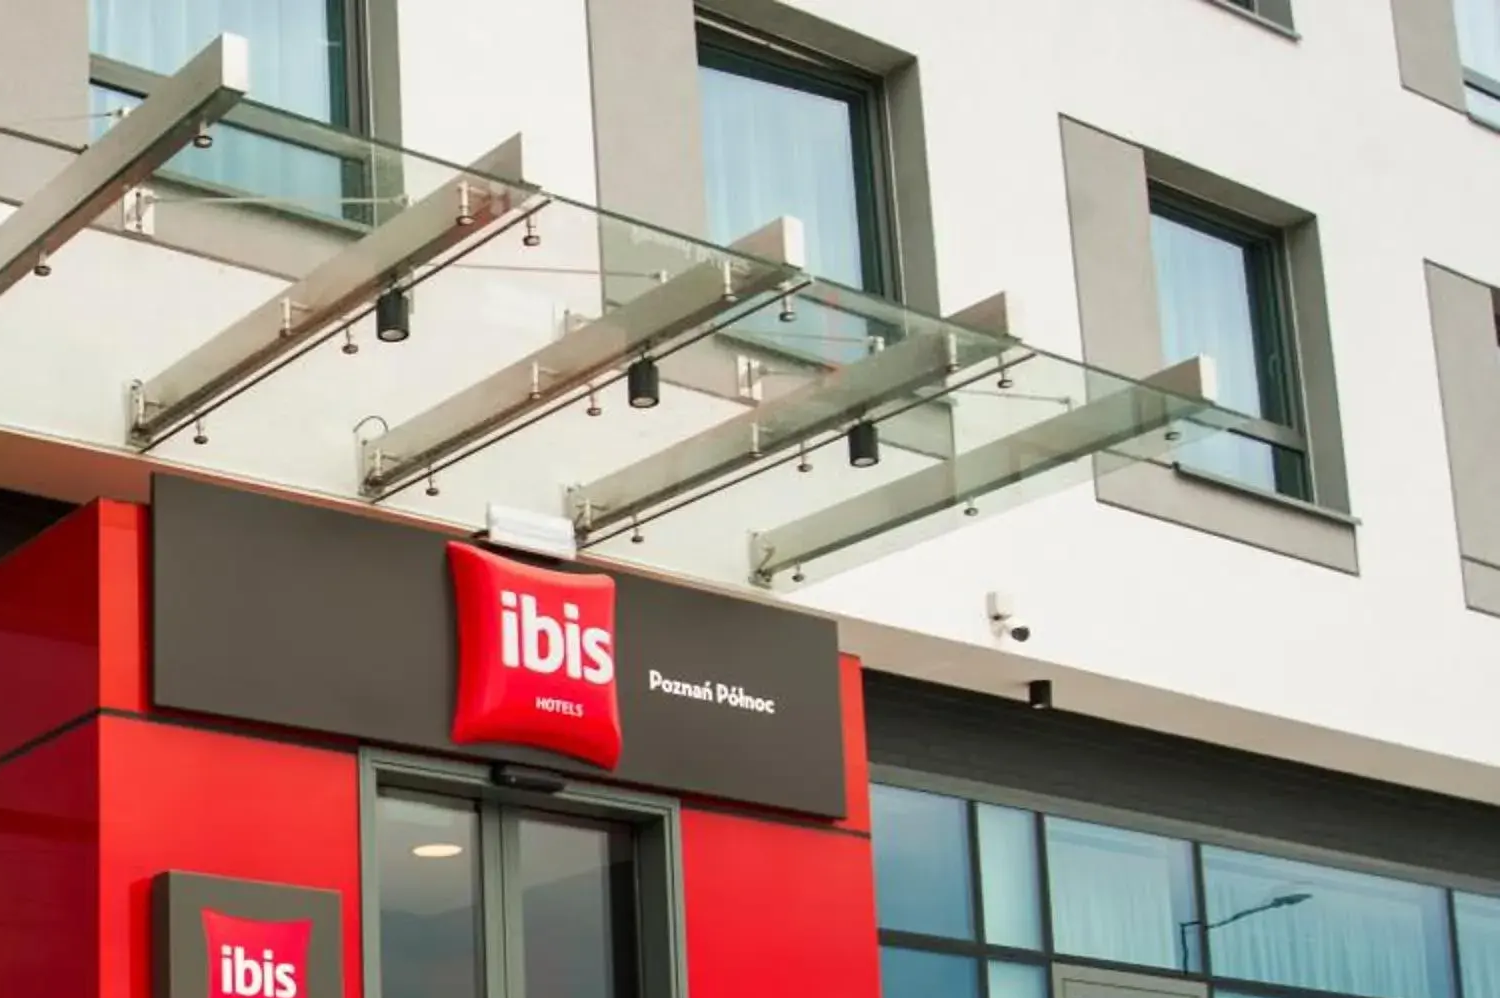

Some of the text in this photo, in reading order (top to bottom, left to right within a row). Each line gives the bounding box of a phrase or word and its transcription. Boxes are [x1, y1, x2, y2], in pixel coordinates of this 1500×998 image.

[500, 590, 614, 685] ibis
[535, 697, 584, 718] HOTELS
[649, 669, 775, 714] Poznań Północ
